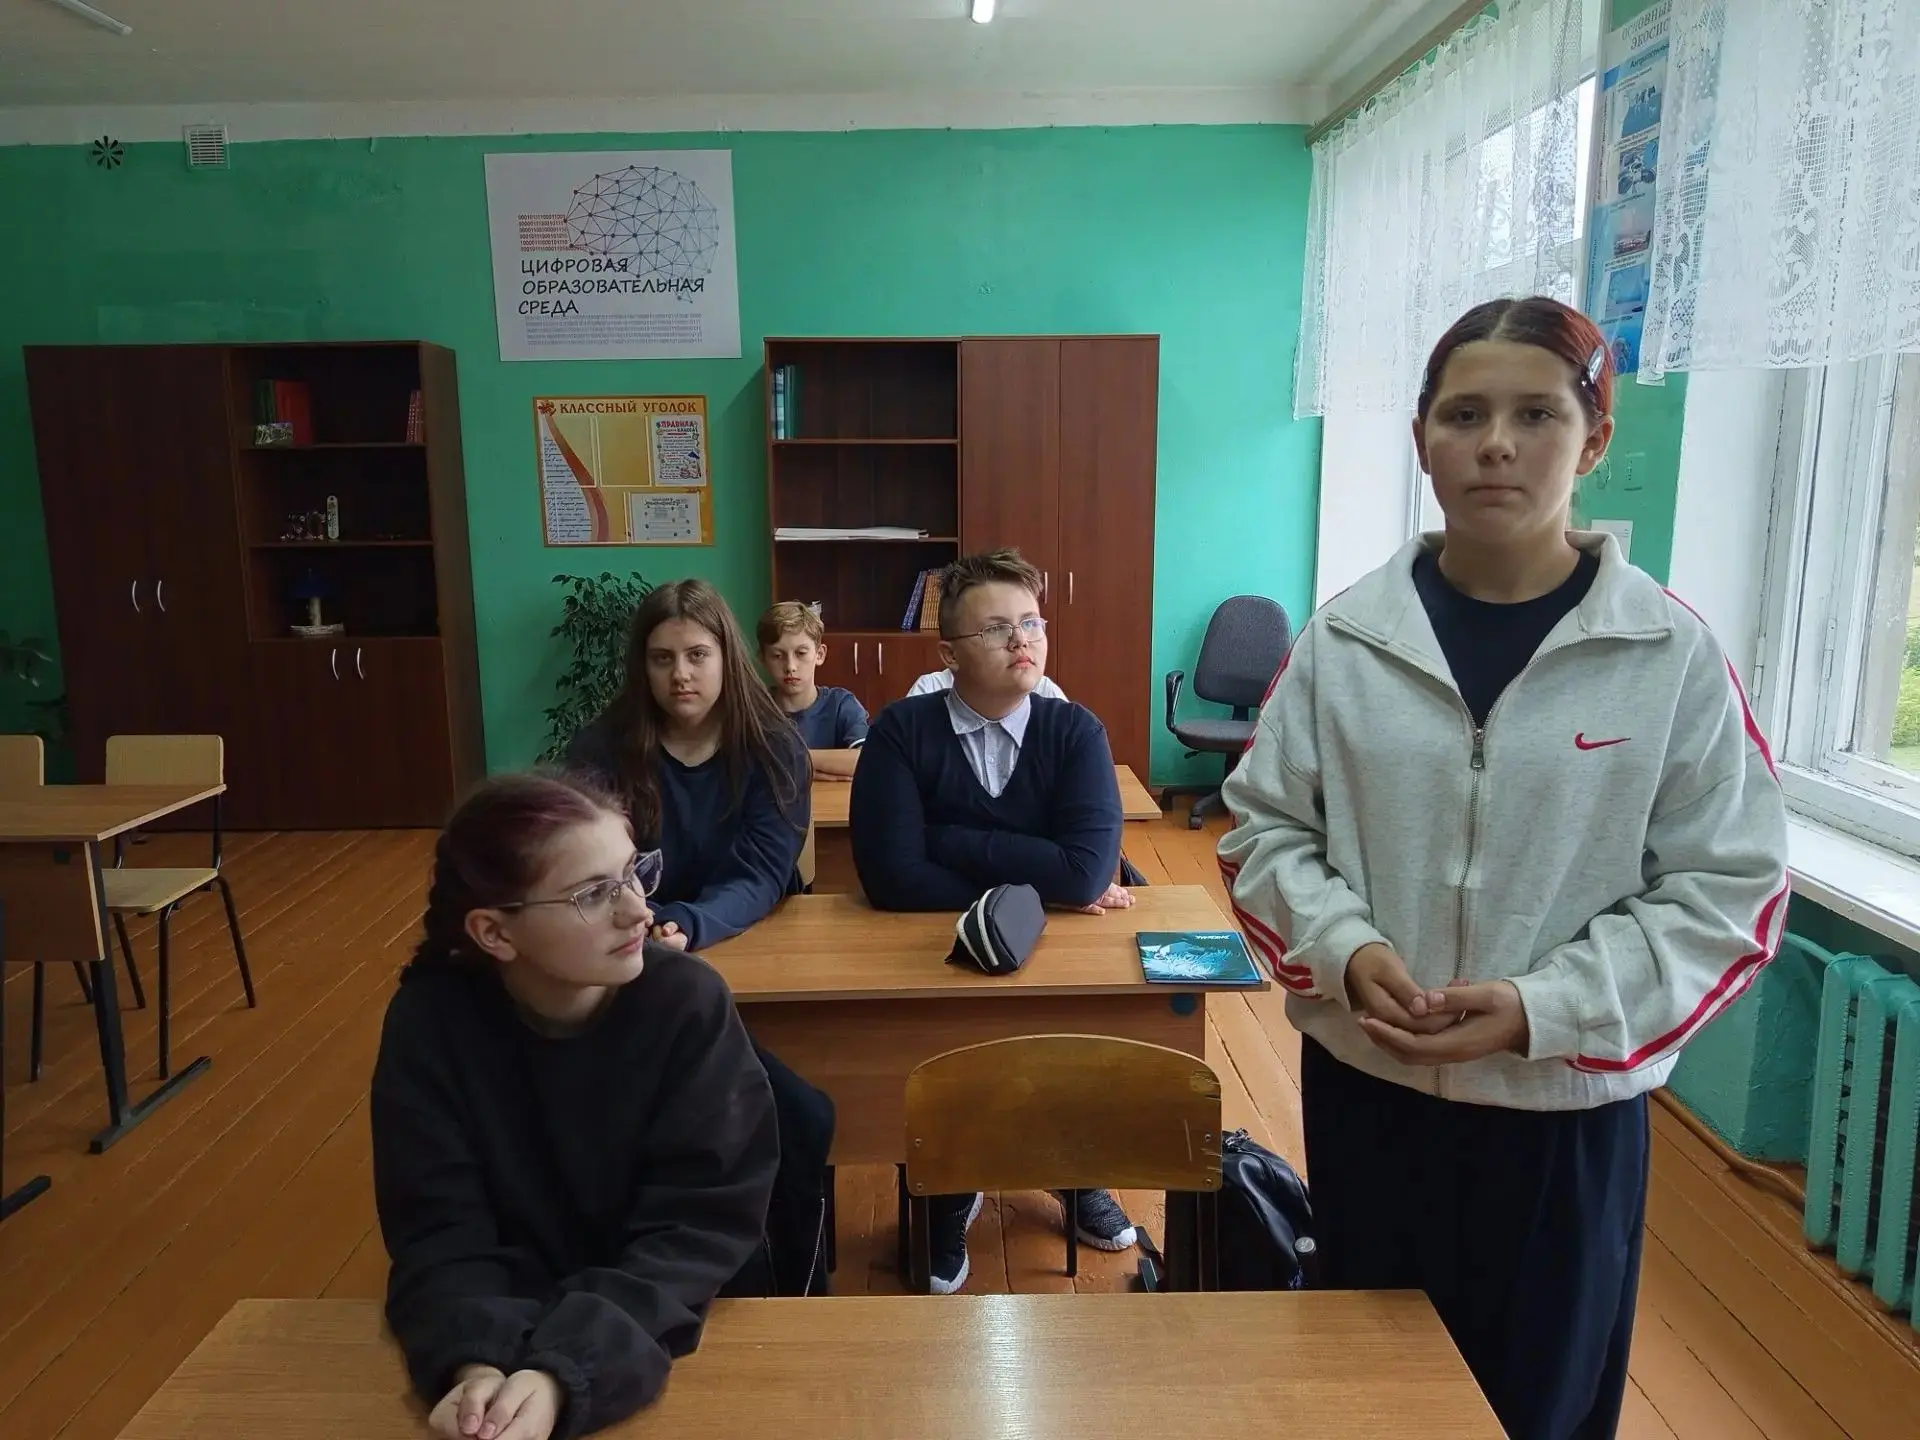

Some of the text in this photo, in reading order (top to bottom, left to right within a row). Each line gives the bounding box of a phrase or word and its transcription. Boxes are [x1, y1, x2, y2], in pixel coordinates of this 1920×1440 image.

[1630, 17, 1671, 50] ЭКОСИС
[521, 257, 629, 275] ЦИФРОВАЯ
[522, 277, 705, 295] ОБРАЗОВАТЕЛЬНАЯ
[518, 299, 579, 318] СРЕДА
[560, 400, 697, 414] КЛАССНЫЙ УГОЛОК
